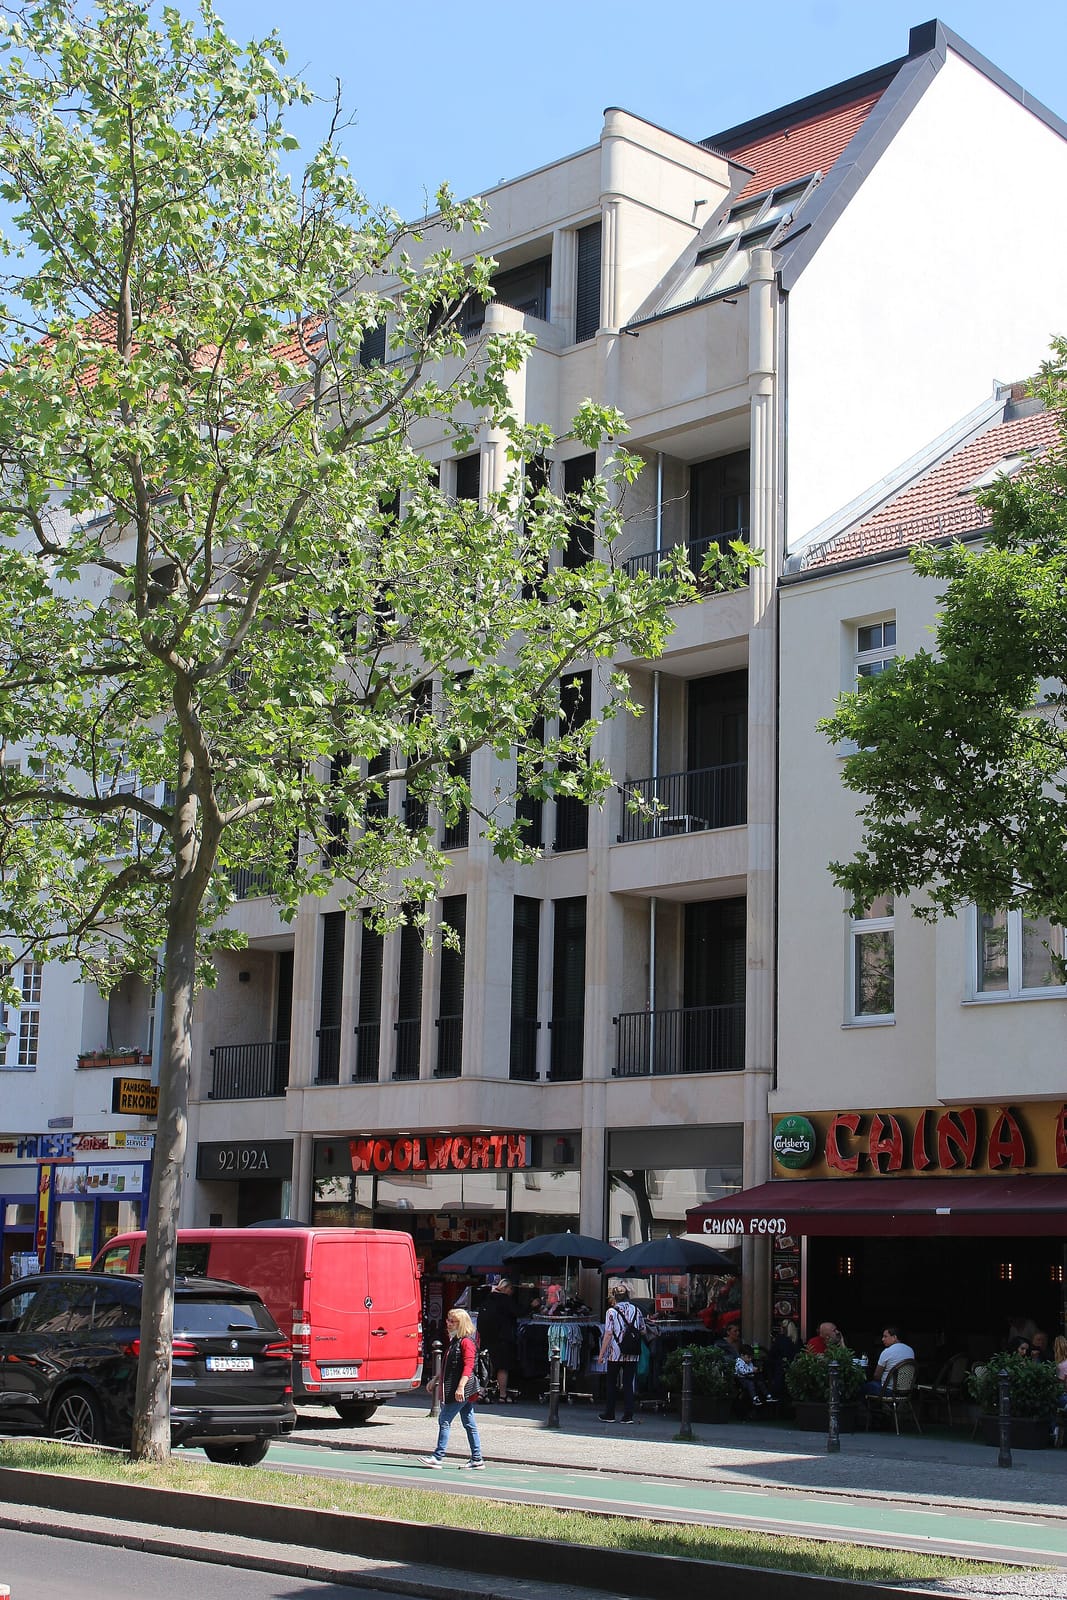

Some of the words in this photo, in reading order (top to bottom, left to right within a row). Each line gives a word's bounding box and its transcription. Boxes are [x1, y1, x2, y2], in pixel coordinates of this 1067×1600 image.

[121, 1094, 157, 1109] REKORD
[126, 1139, 148, 1147] SERVICE
[773, 1135, 810, 1152] Carlsberg
[824, 1106, 1026, 1175] CHINA
[350, 1135, 527, 1172] WOOLWORTH
[703, 1217, 745, 1234] CHINA
[750, 1218, 787, 1234] FOOD
